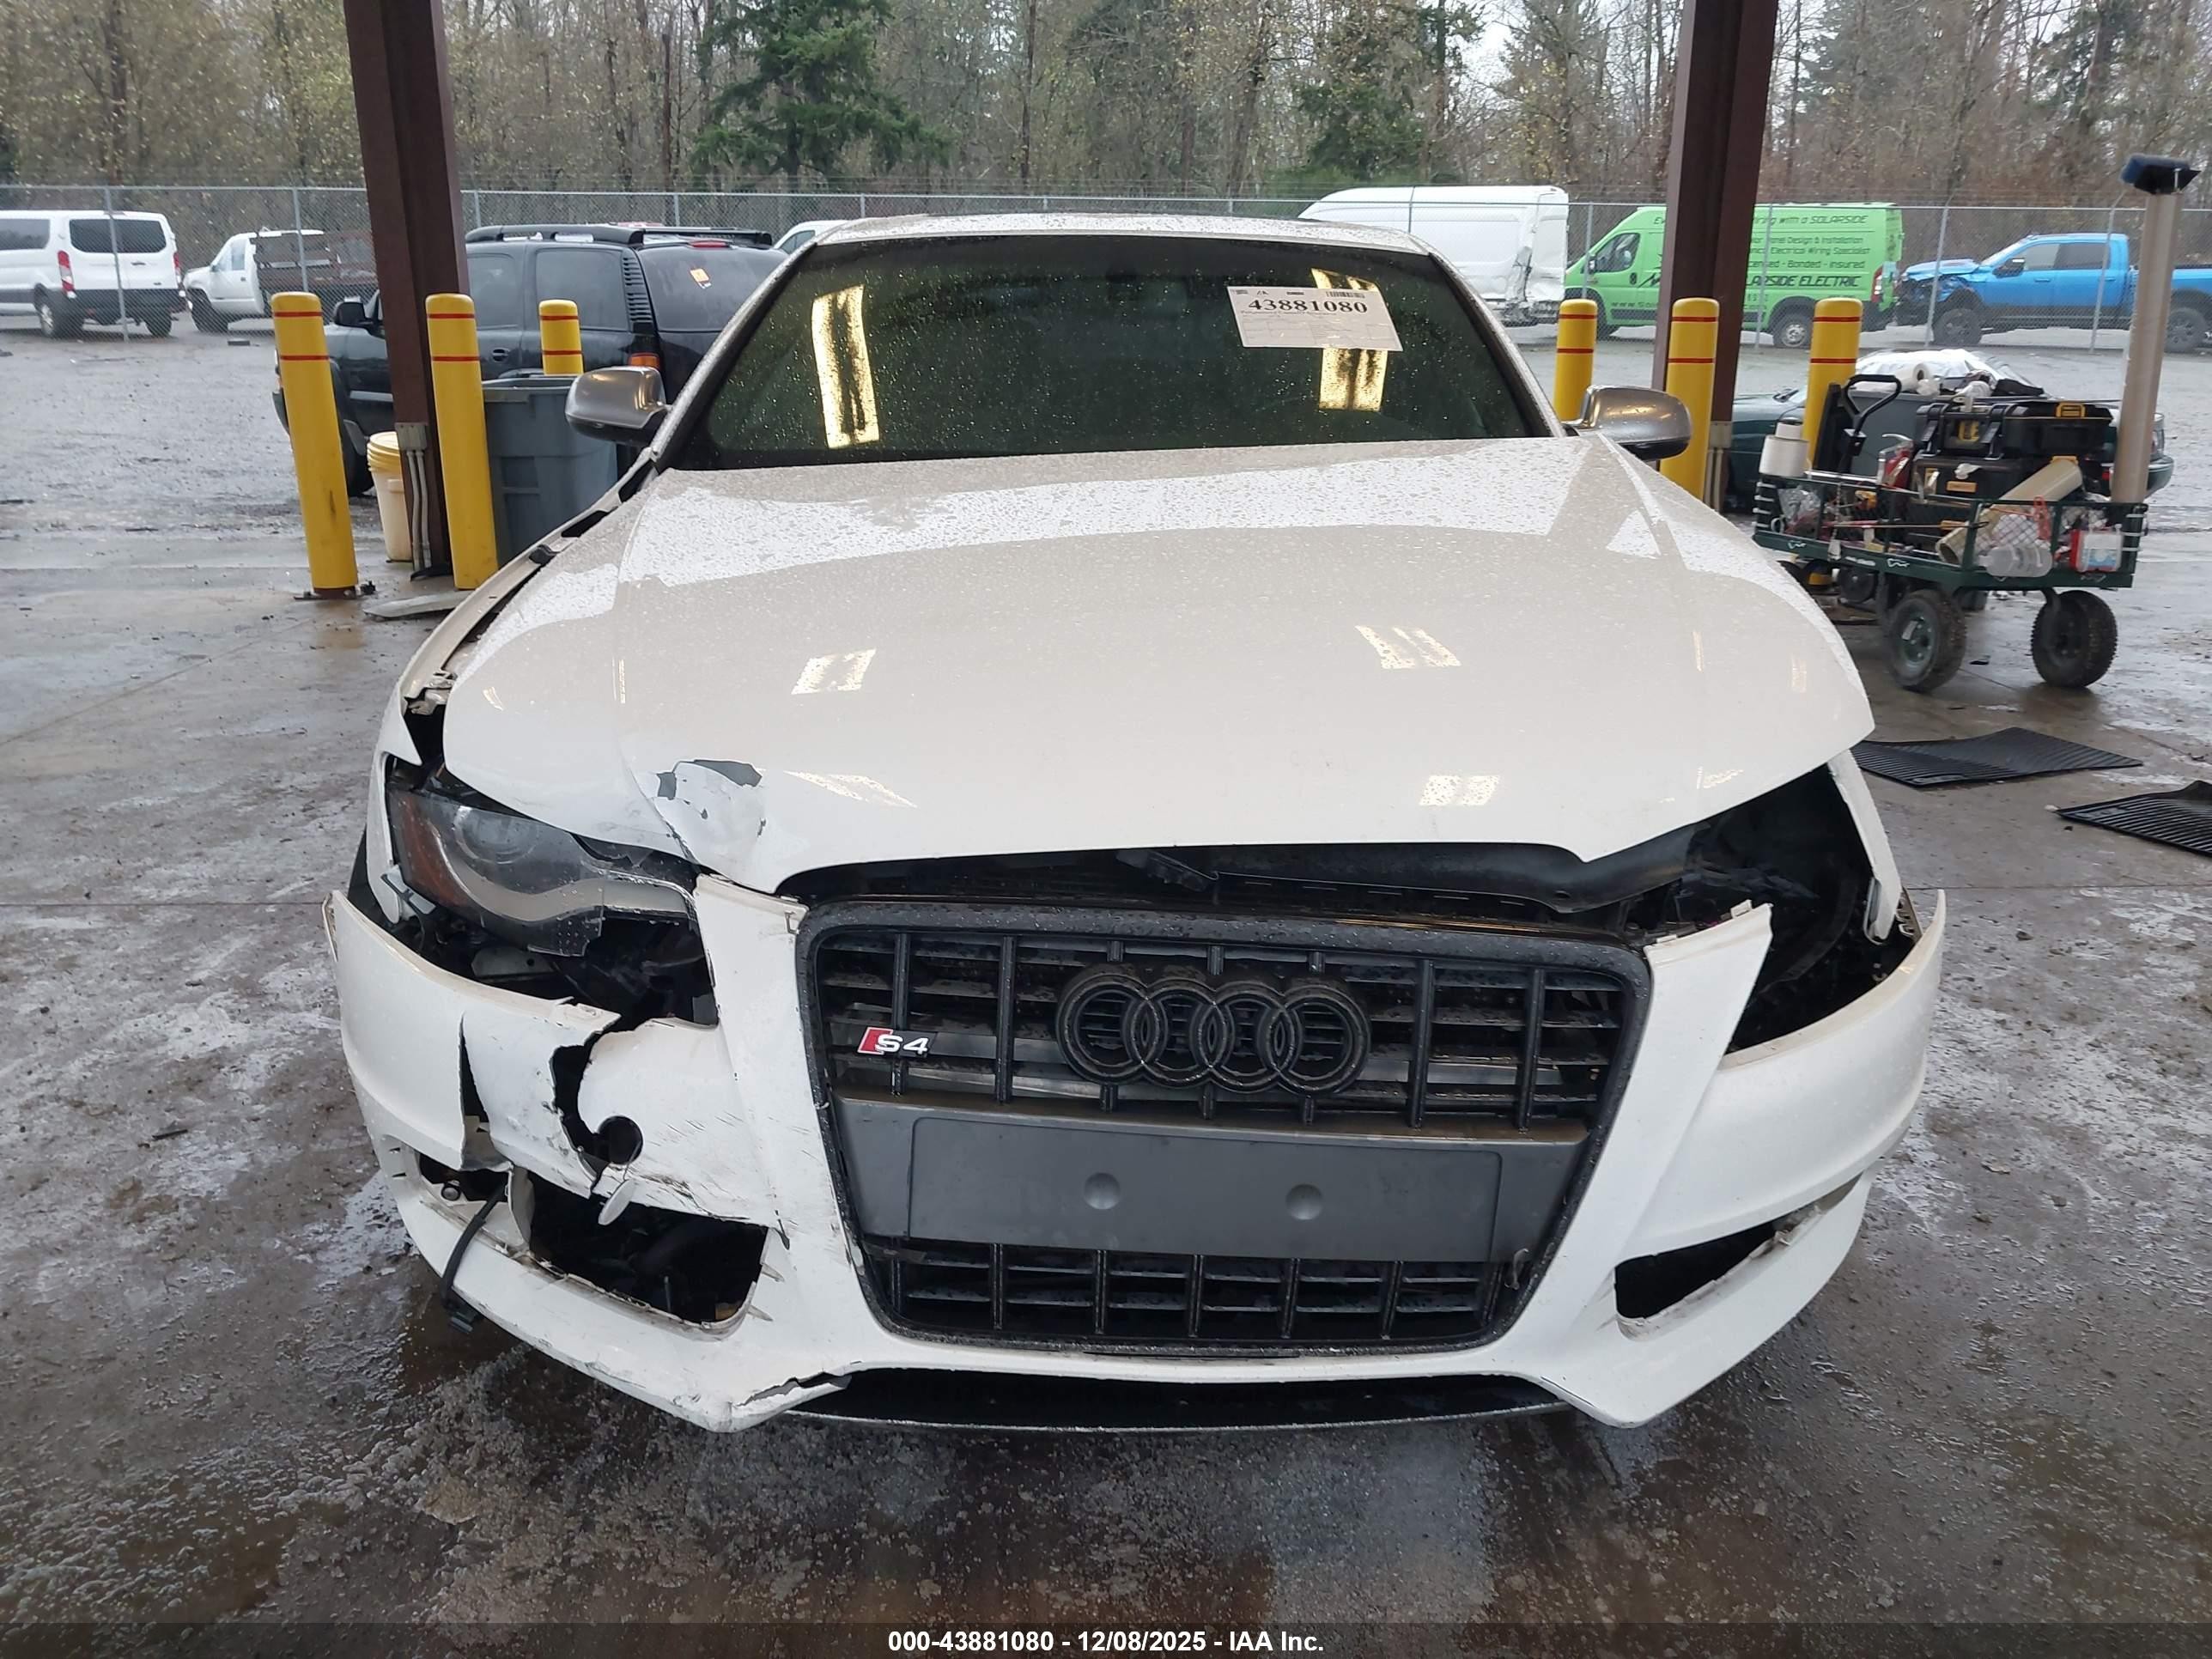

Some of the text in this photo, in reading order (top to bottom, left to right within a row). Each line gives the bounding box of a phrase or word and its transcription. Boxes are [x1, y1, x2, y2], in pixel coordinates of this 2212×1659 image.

[1799, 275, 1862, 287] ELECTRIC
[1248, 298, 1368, 313] 43881080
[874, 1033, 929, 1055] S4
